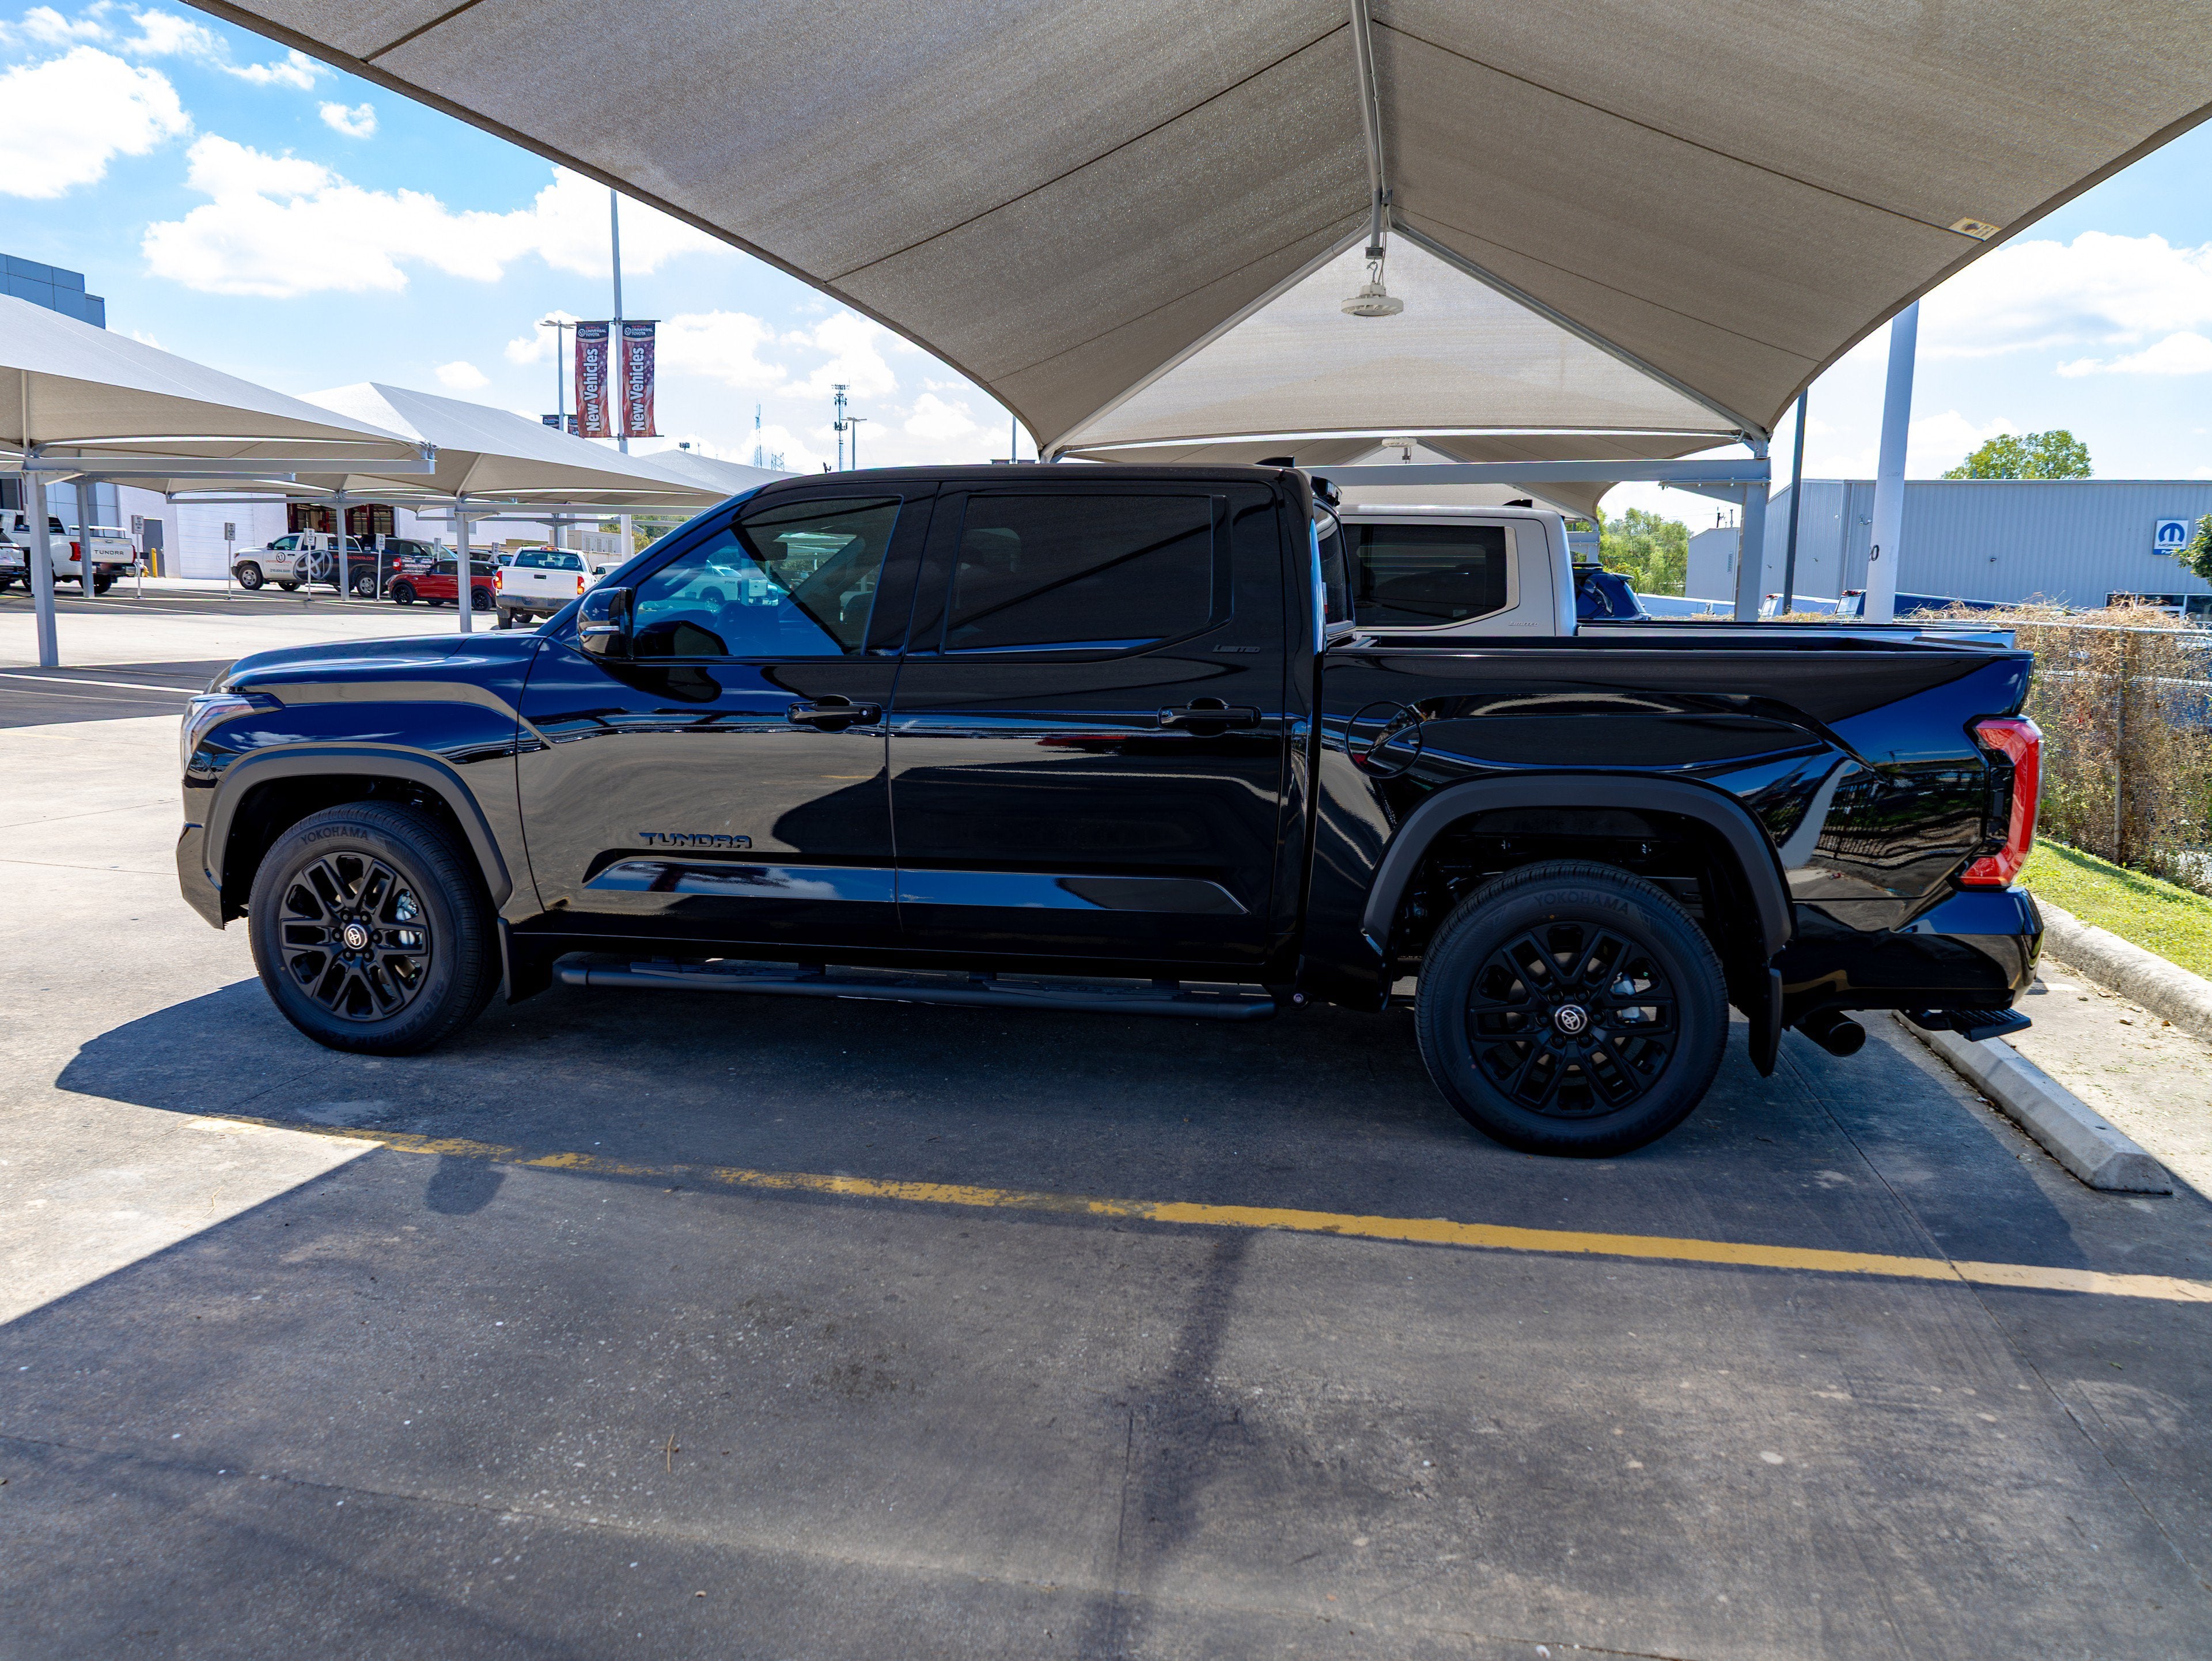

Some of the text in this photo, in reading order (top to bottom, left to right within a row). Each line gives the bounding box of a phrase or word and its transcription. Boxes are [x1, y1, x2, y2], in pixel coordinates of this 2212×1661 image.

[583, 348, 599, 402] Vehicles
[629, 347, 645, 401] Vehicles
[585, 403, 601, 432] New
[630, 402, 646, 432] New
[1213, 644, 1260, 653] LIMITED
[301, 826, 369, 845] YOKOHAMA
[638, 832, 753, 849] TUNDRA
[1533, 890, 1631, 915] YOKOHAMA
